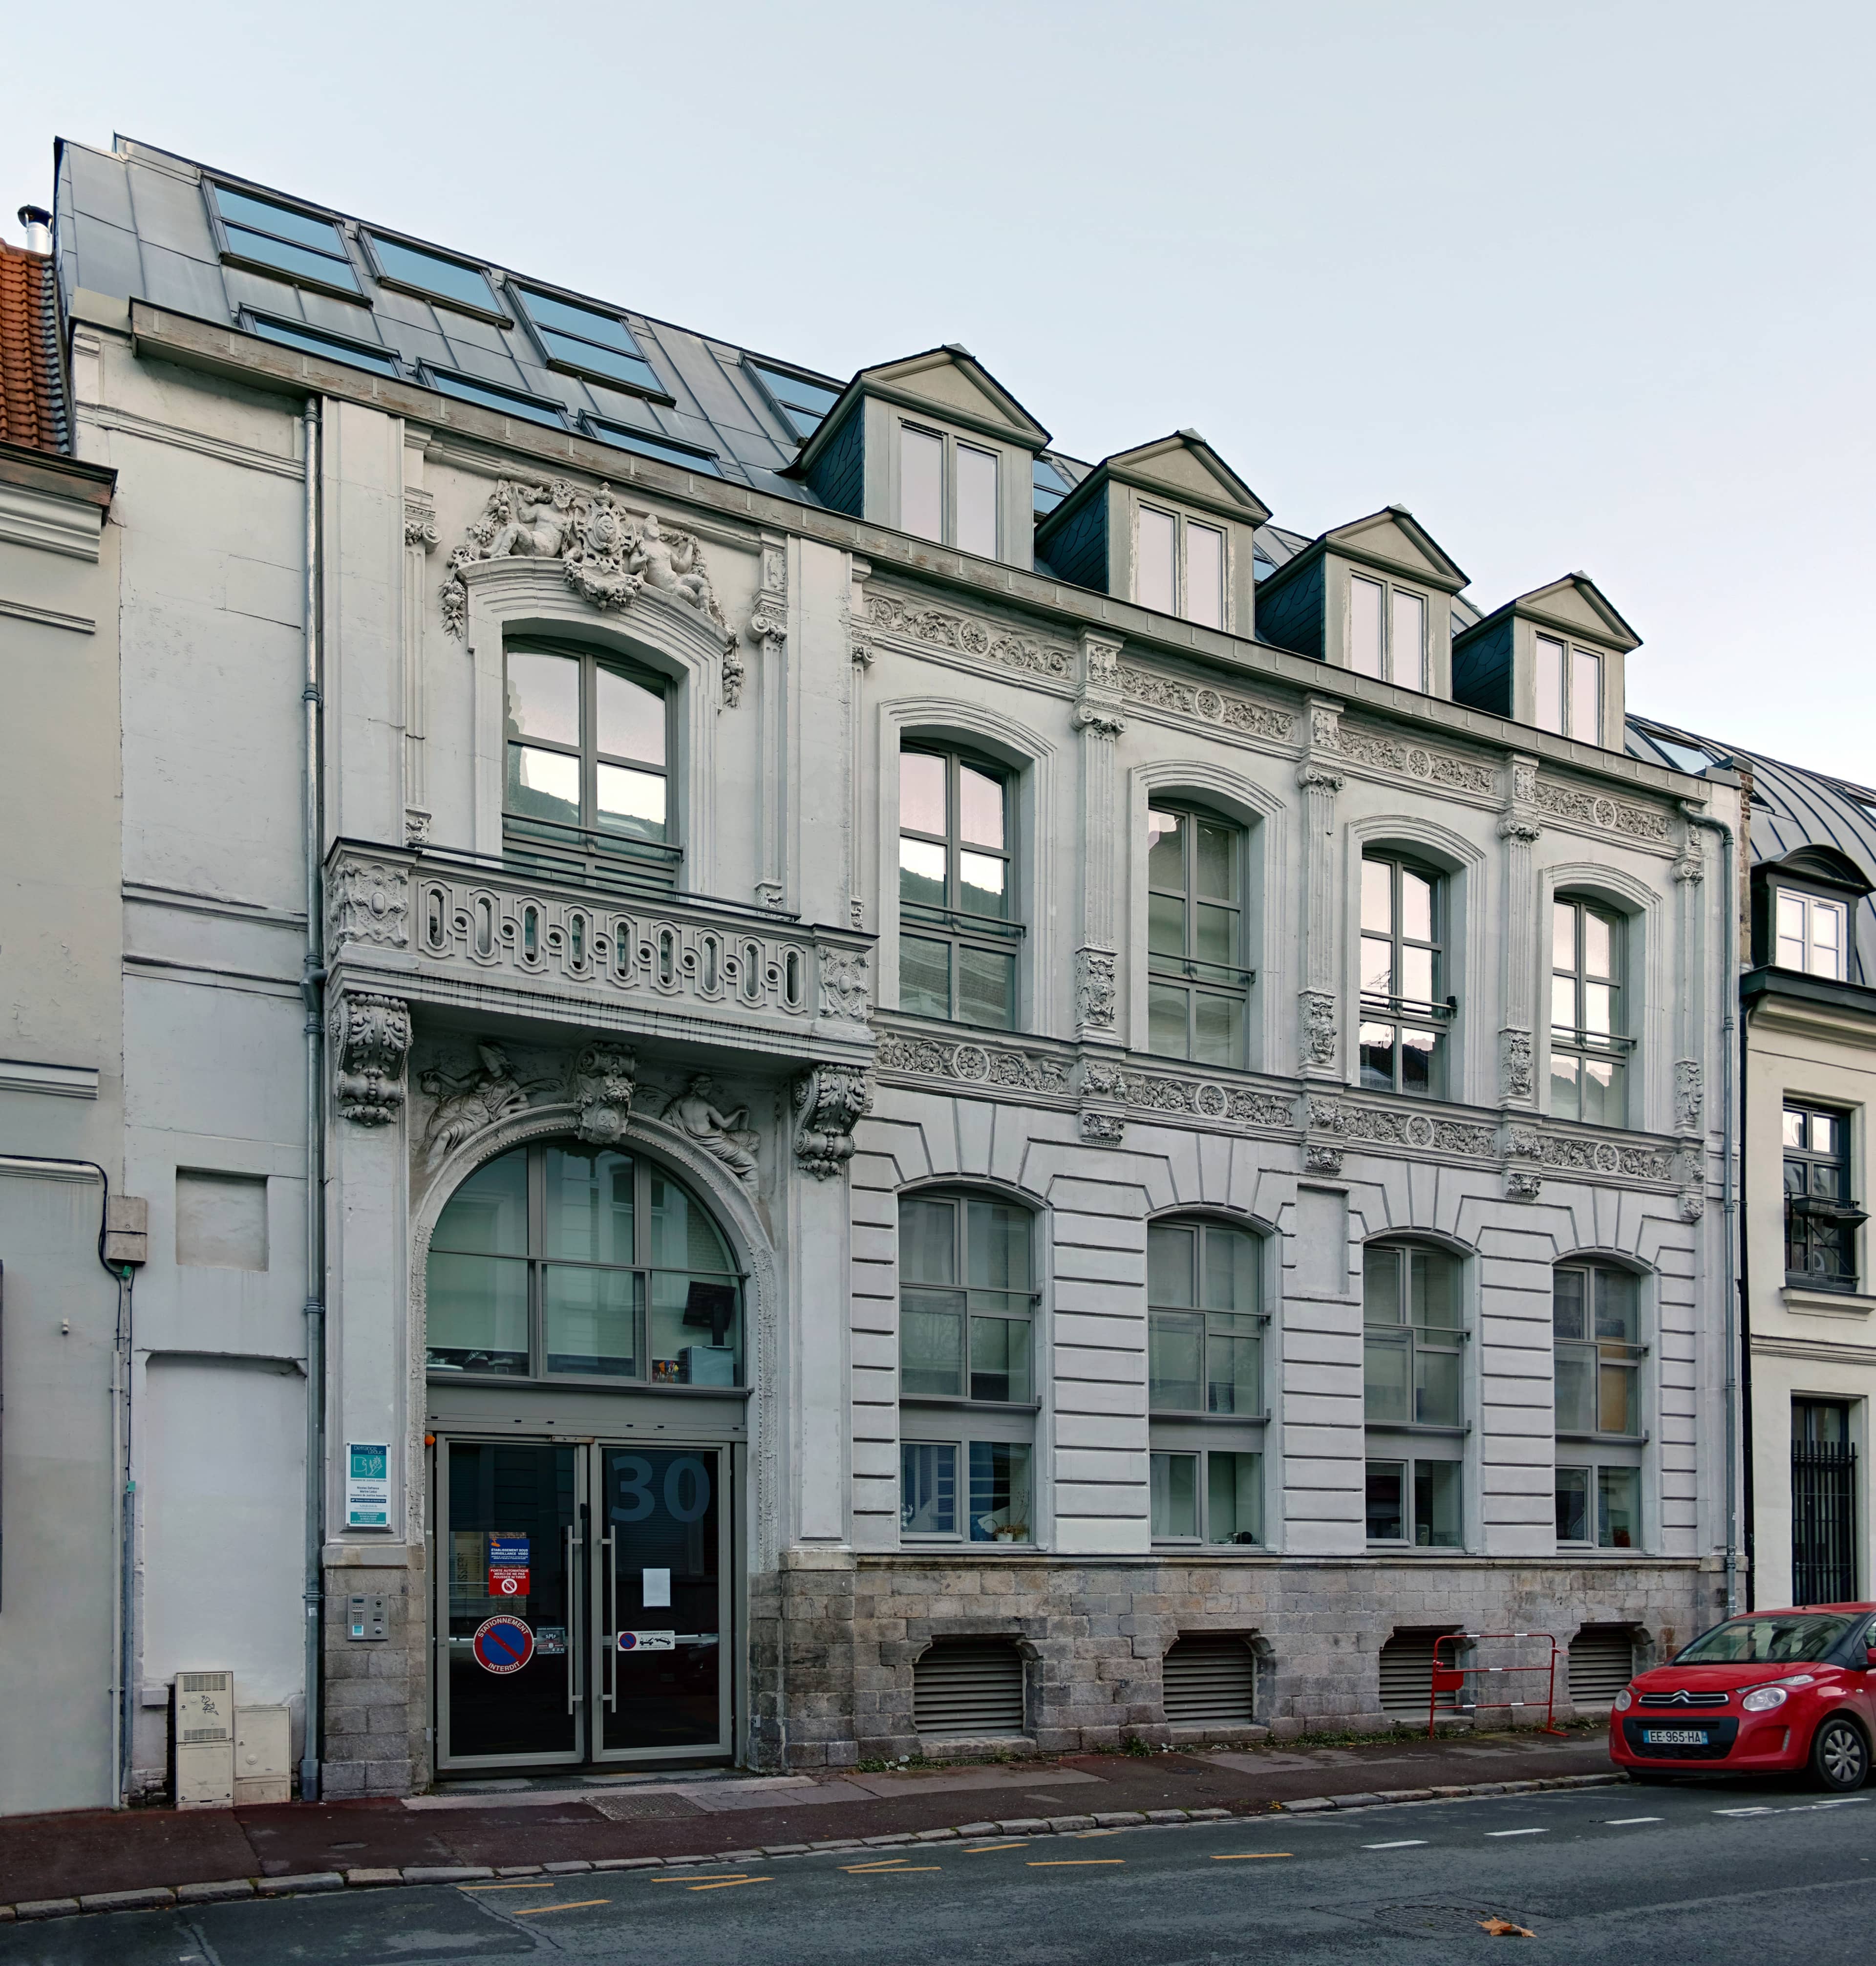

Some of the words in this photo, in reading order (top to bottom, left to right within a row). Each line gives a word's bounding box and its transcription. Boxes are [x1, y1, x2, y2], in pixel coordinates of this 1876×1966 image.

[610, 1455, 710, 1522] 30
[478, 1618, 529, 1638] STATIONNEMENT
[488, 1661, 520, 1672] INTERDIT
[1650, 1731, 1701, 1743] EE-965-HA
